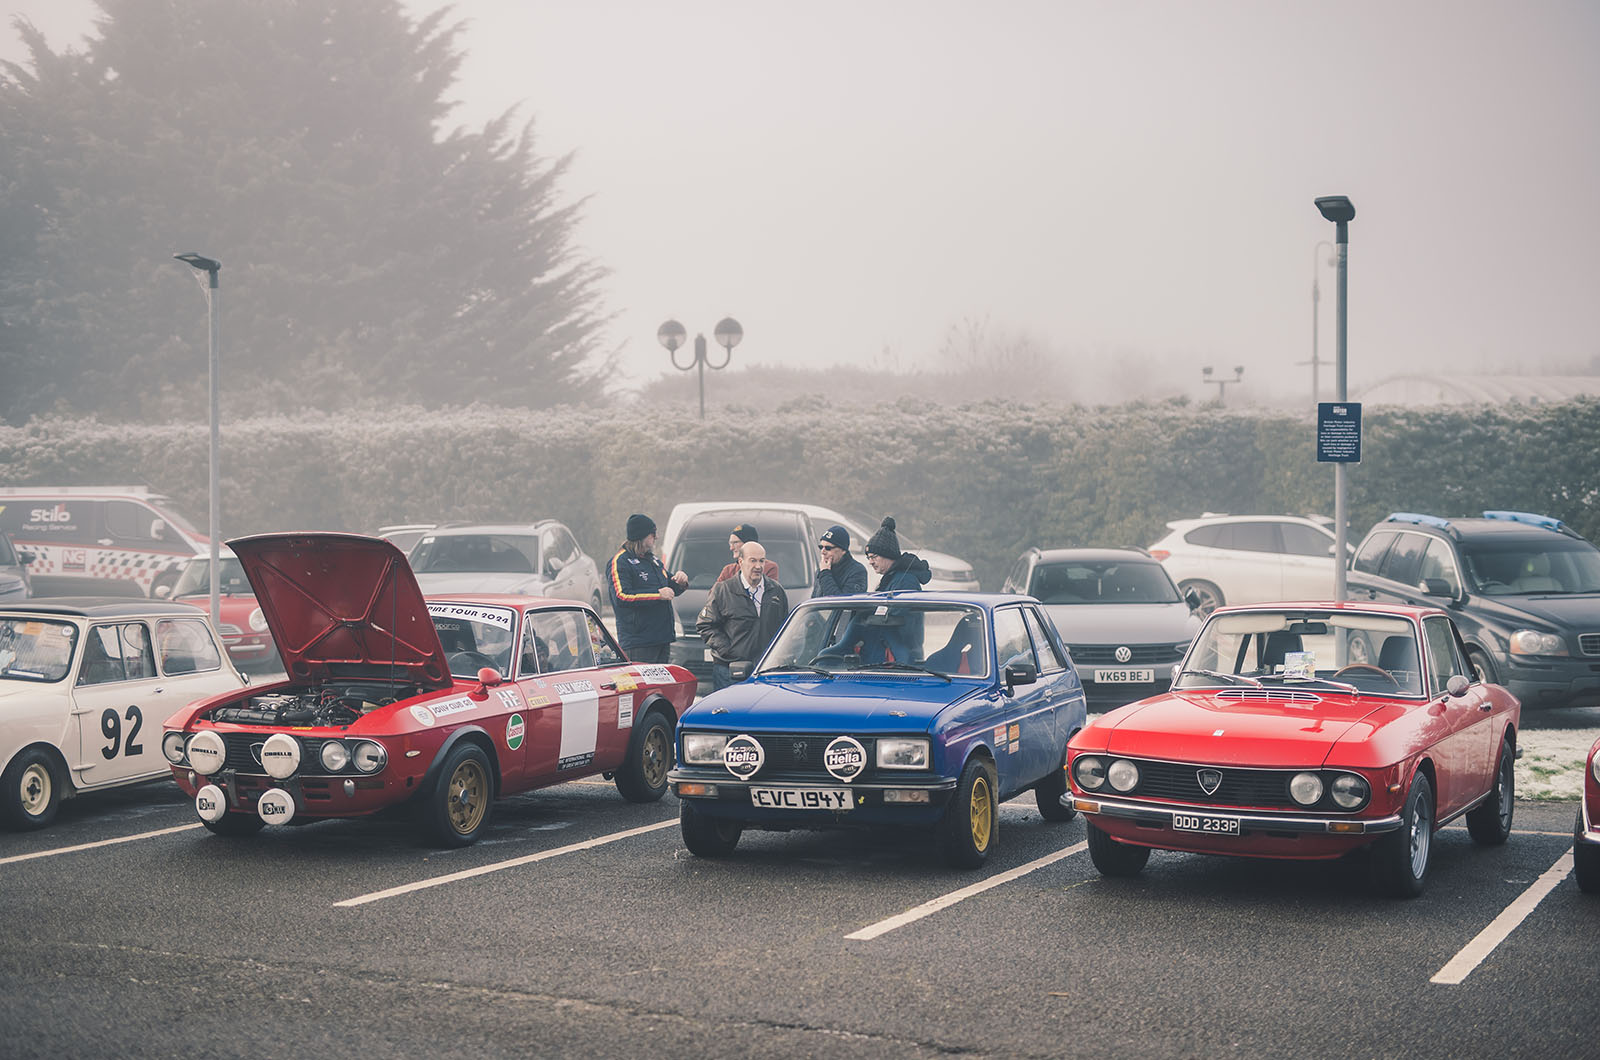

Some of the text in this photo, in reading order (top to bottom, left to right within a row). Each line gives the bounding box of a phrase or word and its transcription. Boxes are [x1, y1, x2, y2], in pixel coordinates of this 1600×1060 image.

[31, 504, 70, 522] Stilo
[450, 607, 478, 617] TOUR
[481, 612, 509, 624] 2024
[1099, 671, 1150, 681] VK69 BEJ
[101, 705, 143, 760] 92
[728, 752, 757, 762] Hella
[829, 753, 859, 764] Hella
[757, 790, 845, 807] CVC 194Y
[1175, 815, 1238, 832] ODD 233P
